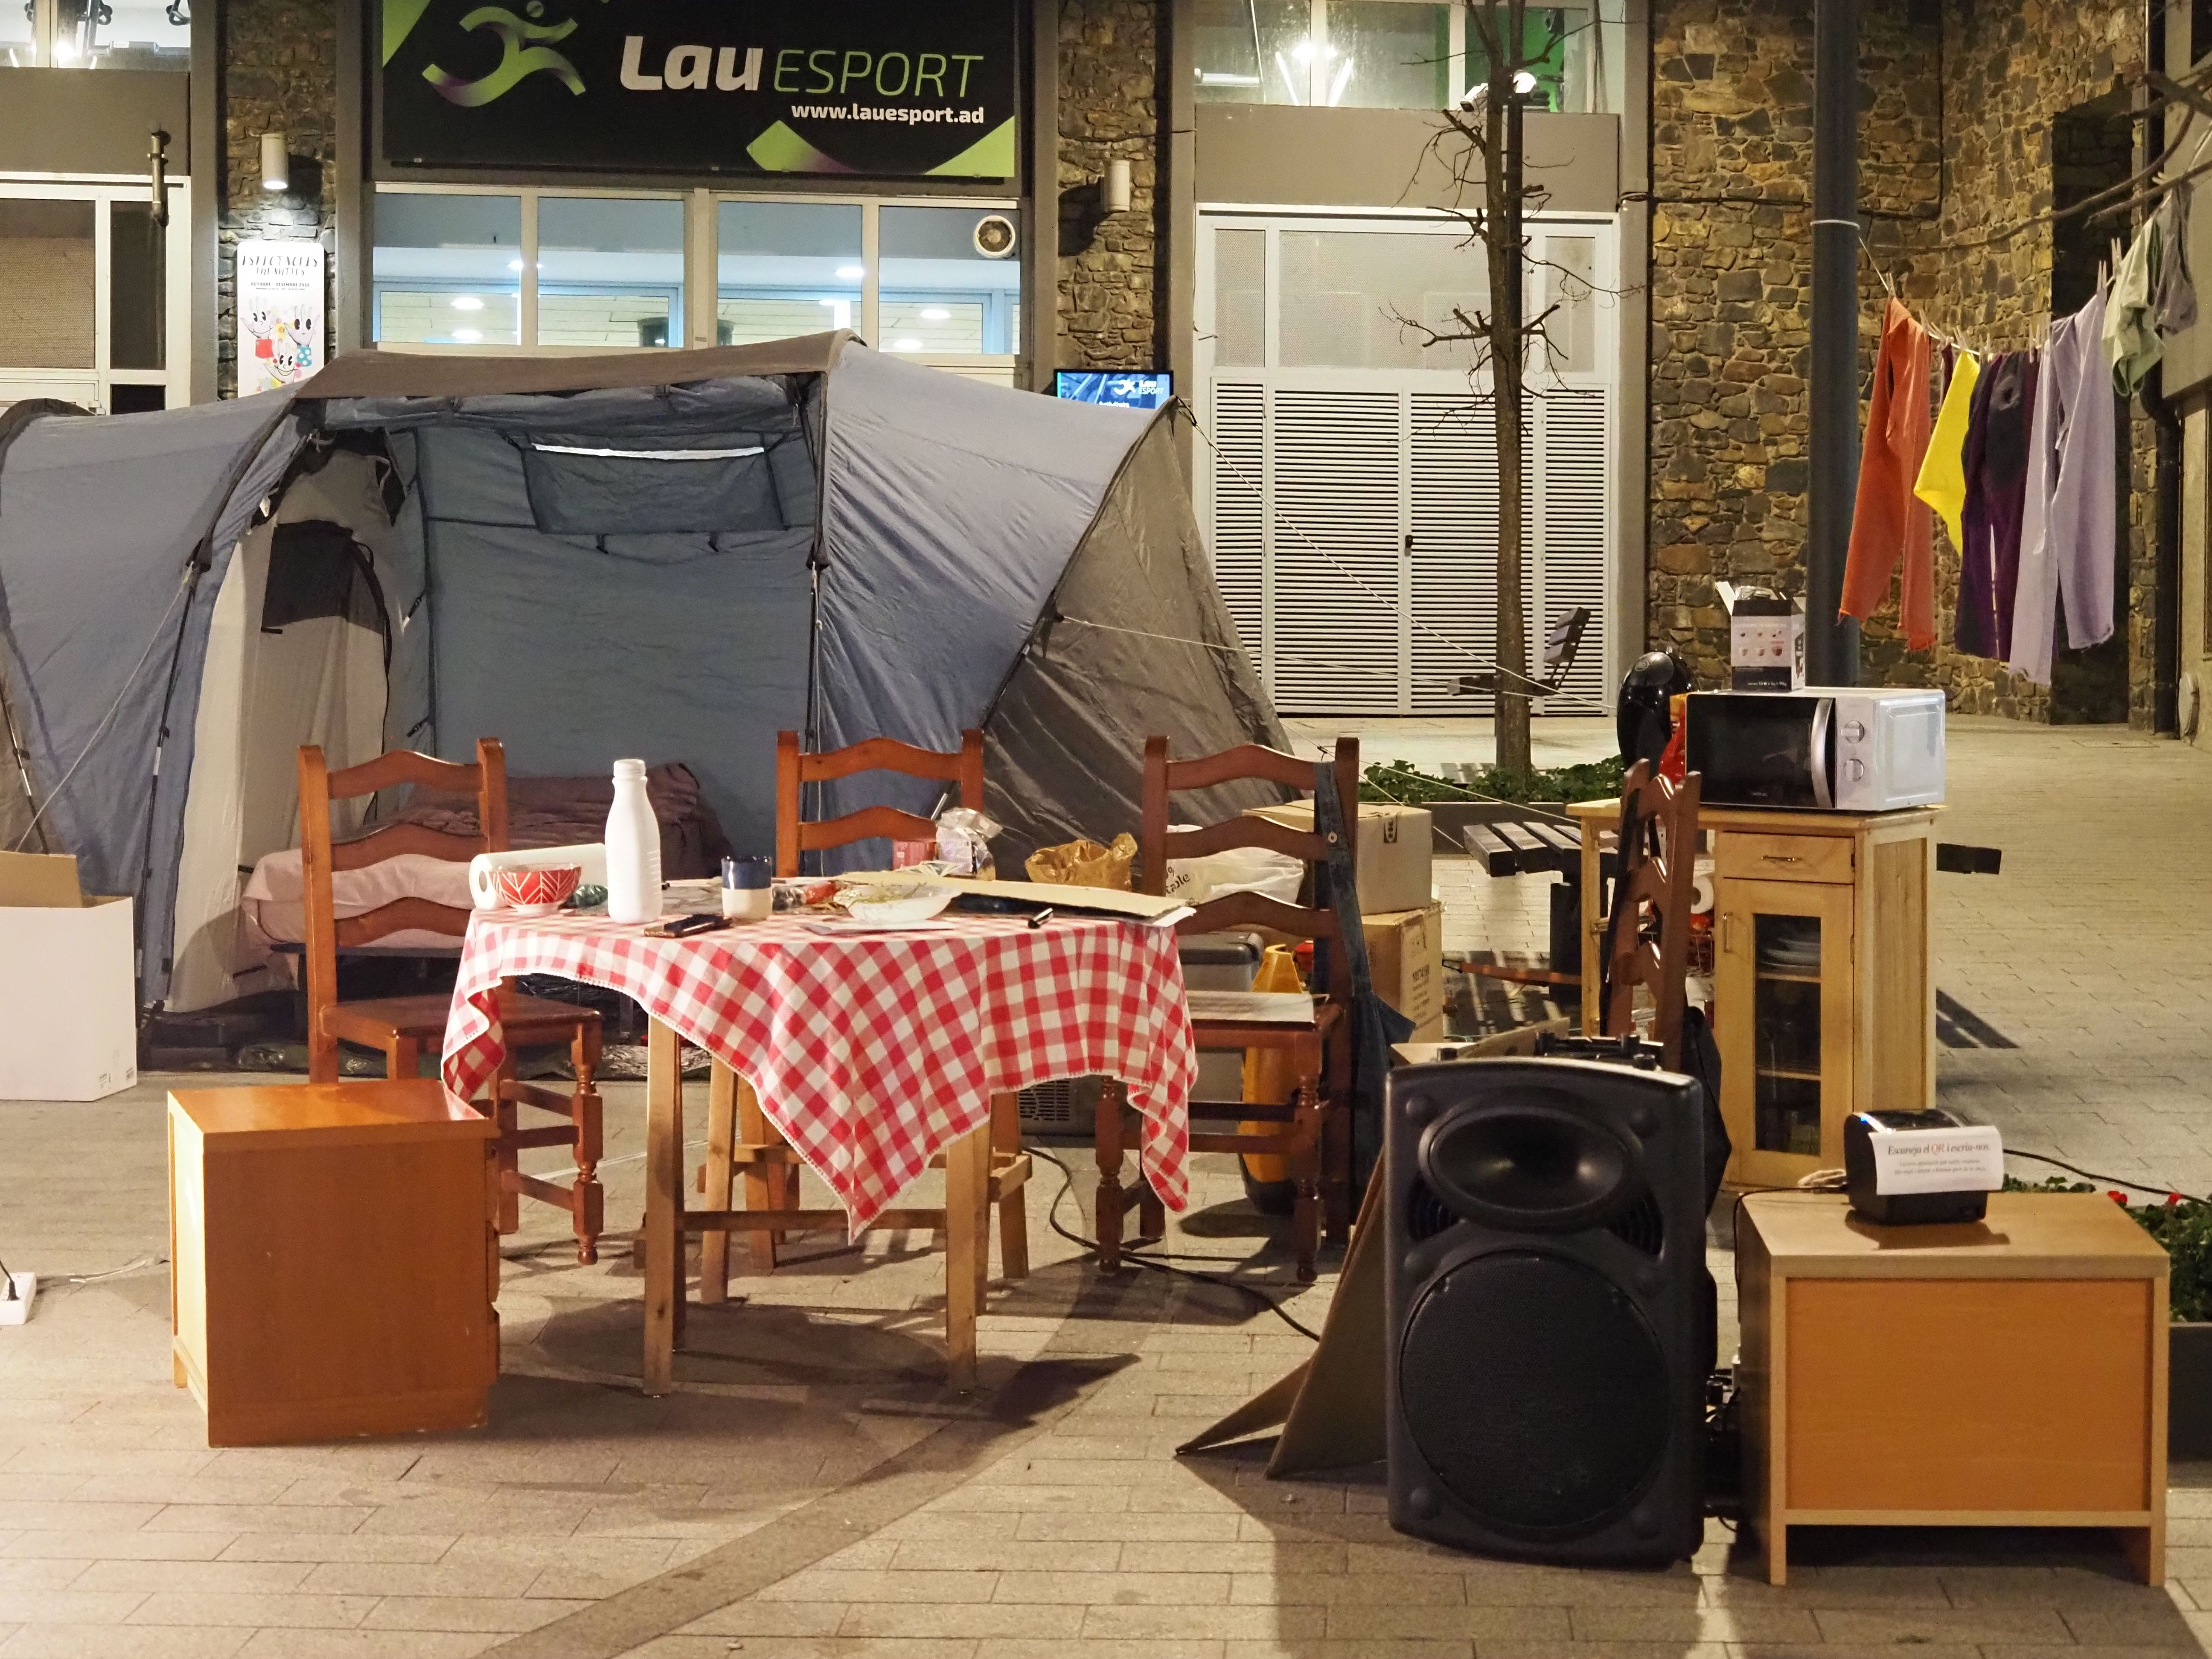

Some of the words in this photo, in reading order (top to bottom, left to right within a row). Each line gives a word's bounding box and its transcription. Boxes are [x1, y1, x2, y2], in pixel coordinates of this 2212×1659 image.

[620, 35, 764, 91] Lau
[774, 49, 984, 98] ESPORT
[792, 104, 984, 125] www.lauesport.ad
[1888, 1145, 1921, 1156] Escaneja
[1923, 1144, 1930, 1154] el
[1931, 1144, 1945, 1155] QR
